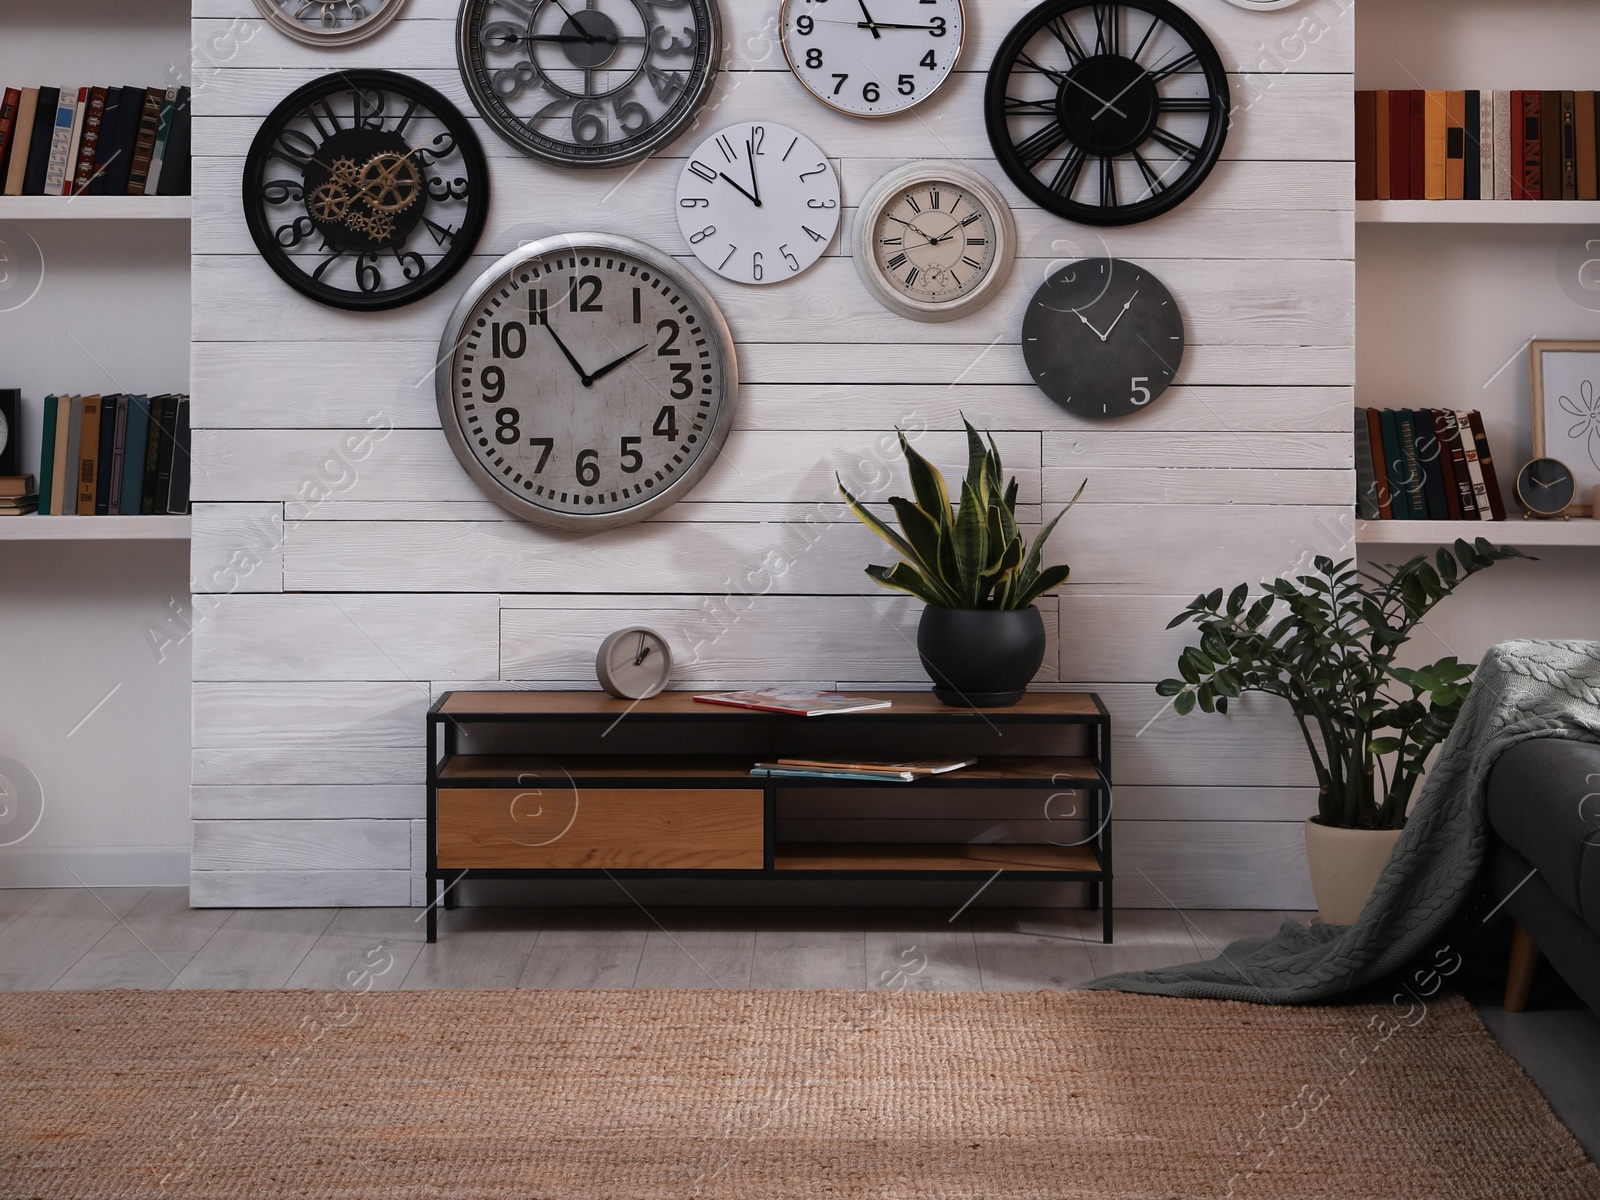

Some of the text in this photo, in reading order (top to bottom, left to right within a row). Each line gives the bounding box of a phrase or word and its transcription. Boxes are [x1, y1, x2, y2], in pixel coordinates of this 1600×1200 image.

[320, 3, 337, 29] 6
[796, 14, 814, 36] 9
[928, 16, 947, 37] 3
[479, 20, 529, 53] 9
[650, 25, 698, 57] 3
[805, 48, 823, 69] 8
[919, 49, 937, 71] 4
[491, 60, 537, 99] 8
[643, 62, 685, 103] 4
[831, 73, 849, 95] 7
[862, 81, 880, 103] 6
[897, 74, 916, 95] 5
[300, 97, 341, 143] 11
[347, 88, 386, 131] 12
[396, 99, 419, 139] 1
[526, 81, 571, 131] 7
[571, 98, 603, 146] 6
[611, 85, 650, 137] 5
[268, 129, 318, 177] 10
[415, 132, 457, 168] 2
[716, 134, 738, 164] 11
[751, 126, 765, 156] 12
[782, 136, 798, 162] 1
[688, 160, 718, 184] 10
[799, 162, 827, 183] 2
[263, 179, 305, 205] 9
[427, 176, 470, 202] 3
[680, 198, 709, 208] 9
[807, 198, 836, 209] 3
[275, 216, 316, 248] 8
[421, 216, 462, 249] 4
[689, 224, 716, 244] 8
[801, 225, 828, 242] 4
[312, 237, 345, 281] 7
[355, 251, 381, 293] 6
[391, 243, 426, 281] 5
[718, 243, 738, 271] 7
[753, 251, 763, 281] 6
[778, 243, 800, 272] 5
[528, 289, 548, 325] 11
[569, 275, 604, 313] 12
[632, 287, 641, 324] 1
[491, 321, 527, 359] 10
[656, 319, 681, 356] 2
[480, 365, 505, 403] 9
[669, 362, 694, 400] 3
[1130, 376, 1151, 406] 5
[495, 407, 520, 444] 8
[652, 405, 679, 442] 4
[529, 437, 554, 474] 7
[575, 449, 600, 487] 6
[620, 436, 643, 474] 5
